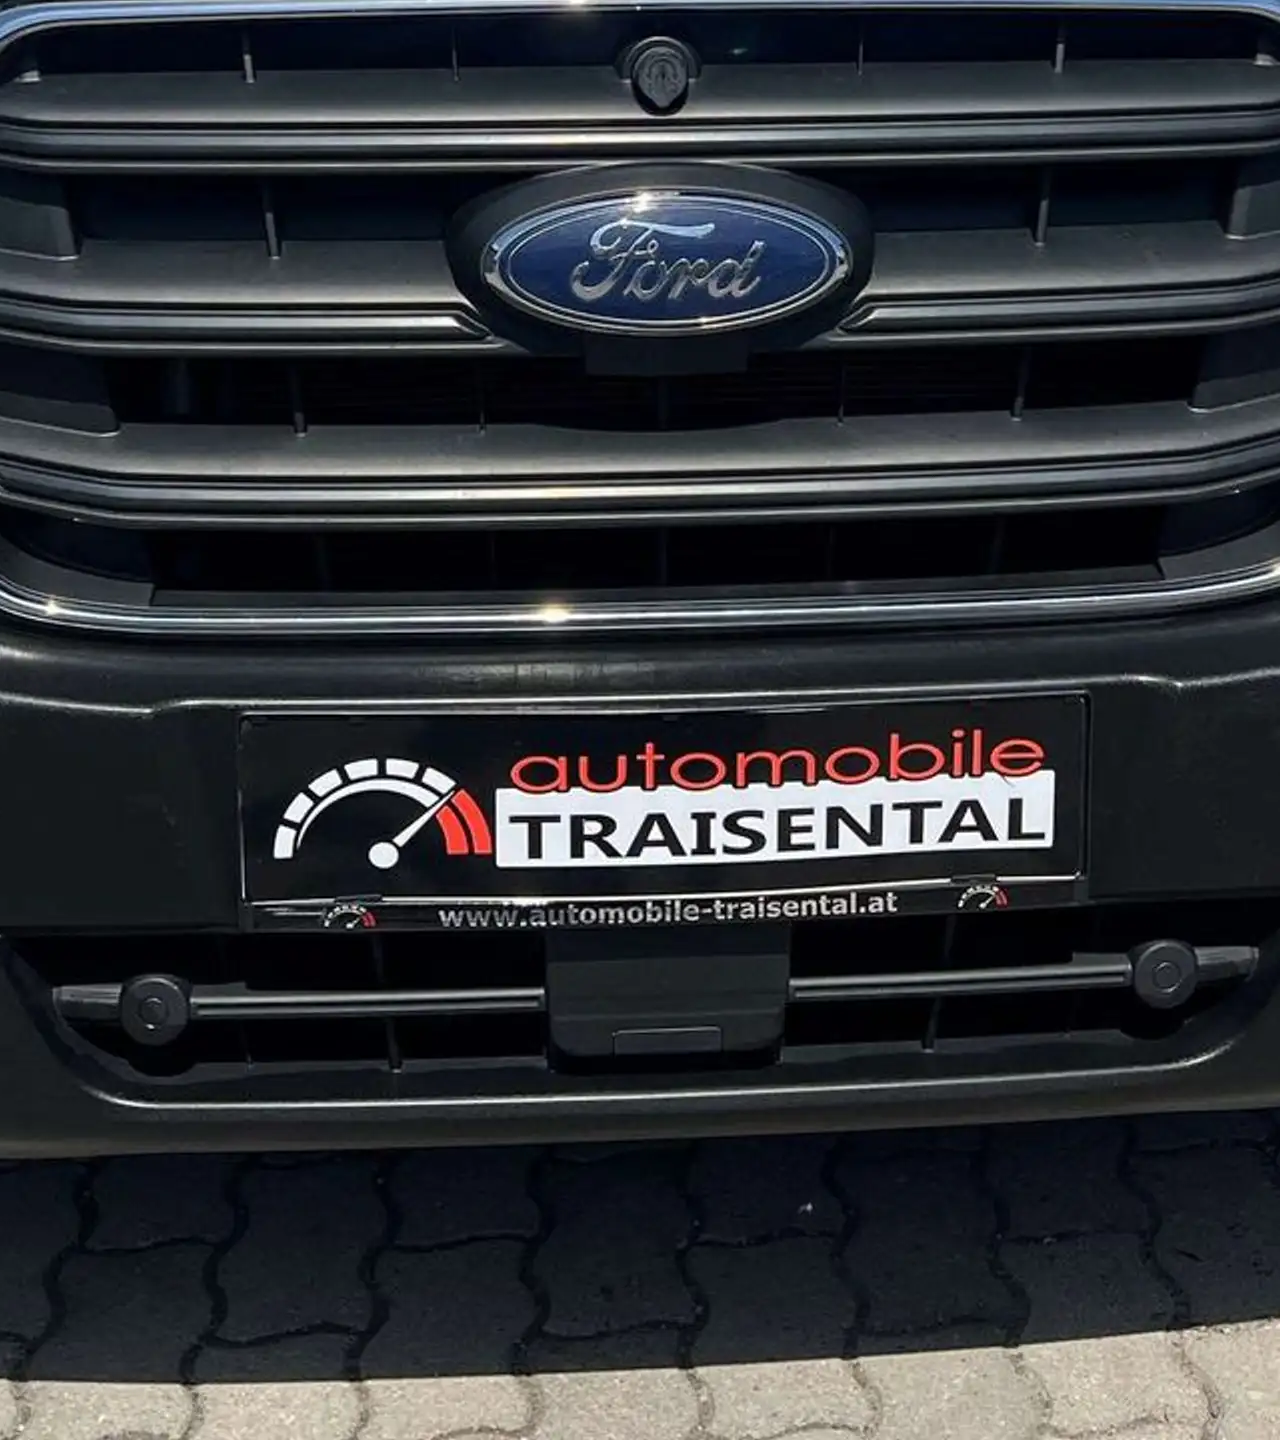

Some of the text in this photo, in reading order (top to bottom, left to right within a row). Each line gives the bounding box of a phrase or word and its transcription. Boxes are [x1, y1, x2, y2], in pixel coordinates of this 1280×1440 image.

[571, 218, 765, 301] Ford
[510, 729, 1045, 794] automobile
[509, 798, 1046, 862] TRAISENTAL
[438, 892, 898, 928] www.automobile-traisental.at
